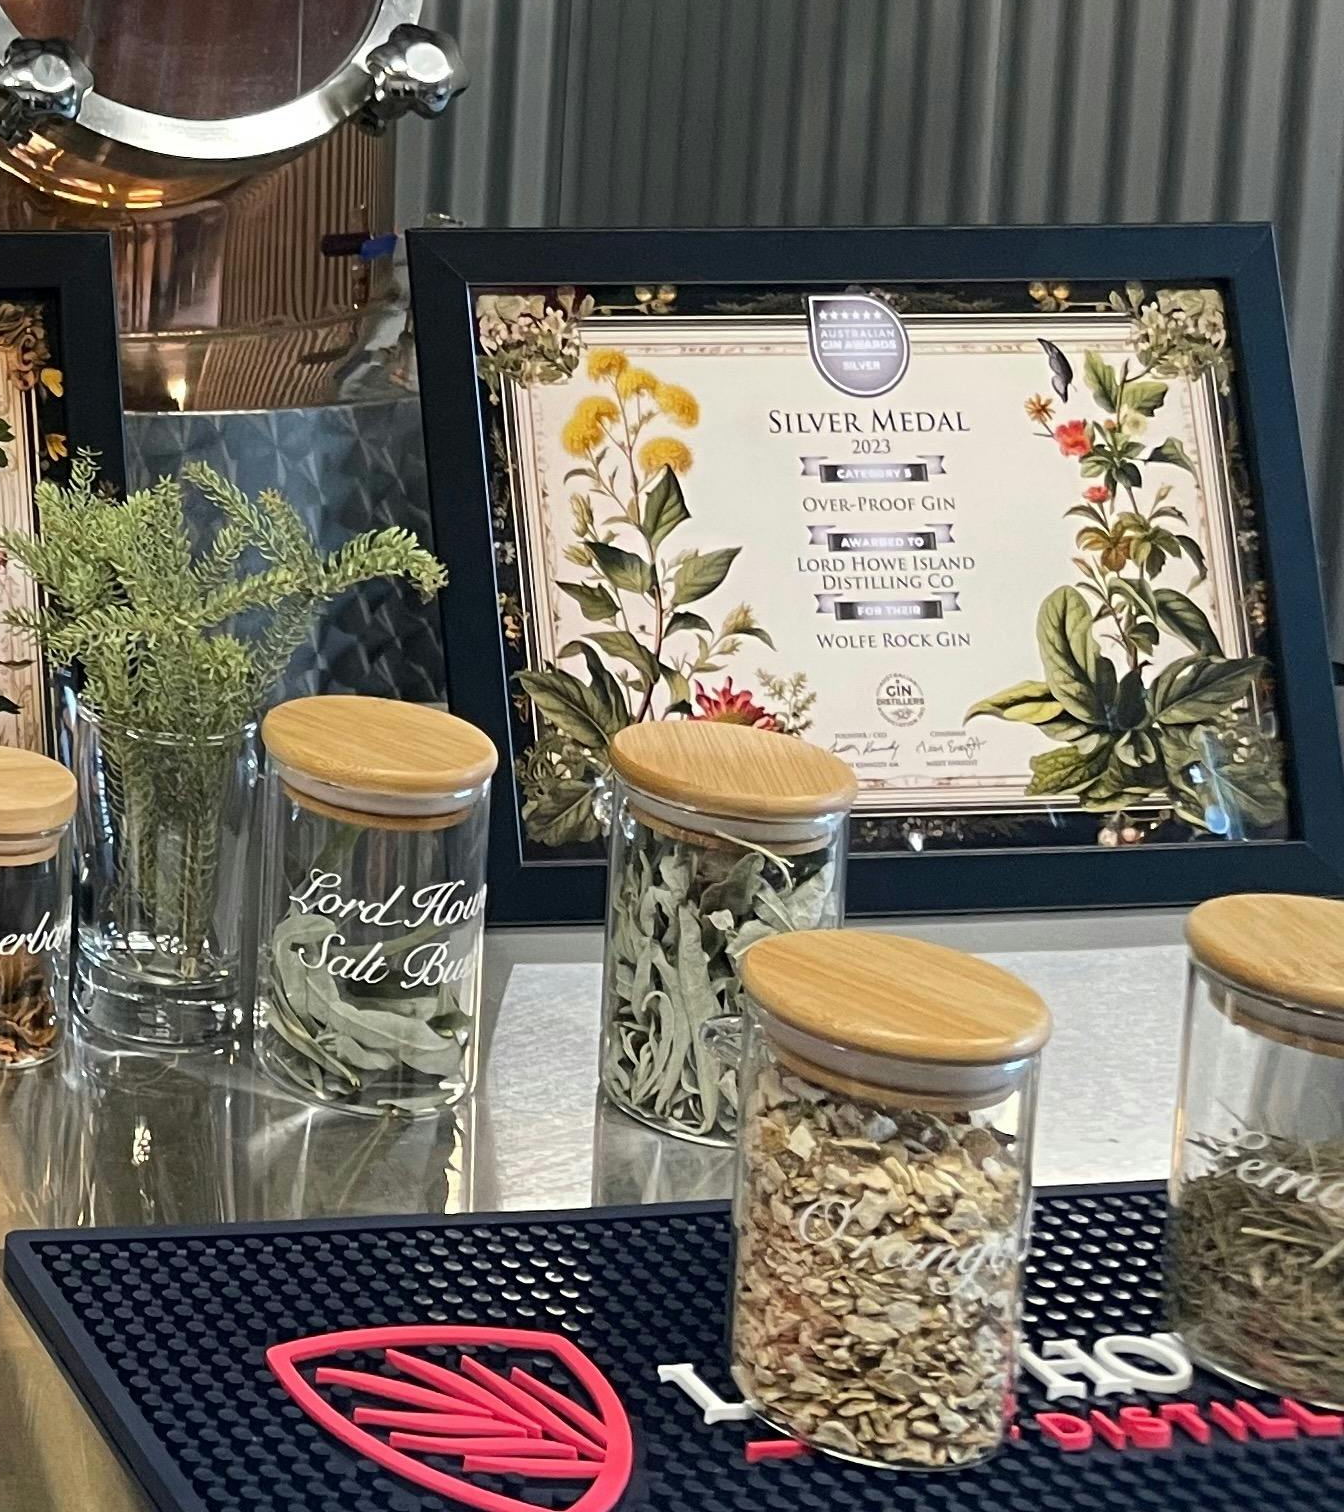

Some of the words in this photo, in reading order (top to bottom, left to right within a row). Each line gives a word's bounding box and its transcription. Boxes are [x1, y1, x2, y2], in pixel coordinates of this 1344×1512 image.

[768, 409, 863, 434] SILVER
[871, 408, 972, 433] MEDAL
[852, 439, 891, 454] 2023
[803, 496, 917, 512] OVER-PROOF
[921, 496, 956, 511] GIN
[797, 556, 845, 572] LORD
[852, 556, 907, 572] HOWE
[912, 555, 976, 571] ISLAND
[822, 574, 922, 590] DISTILLING
[816, 633, 877, 649] WOLFE
[883, 632, 933, 648] ROCK
[936, 631, 971, 647] GIN
[886, 685, 912, 697] GIN
[289, 868, 406, 927] Lord
[298, 933, 390, 984] Salt
